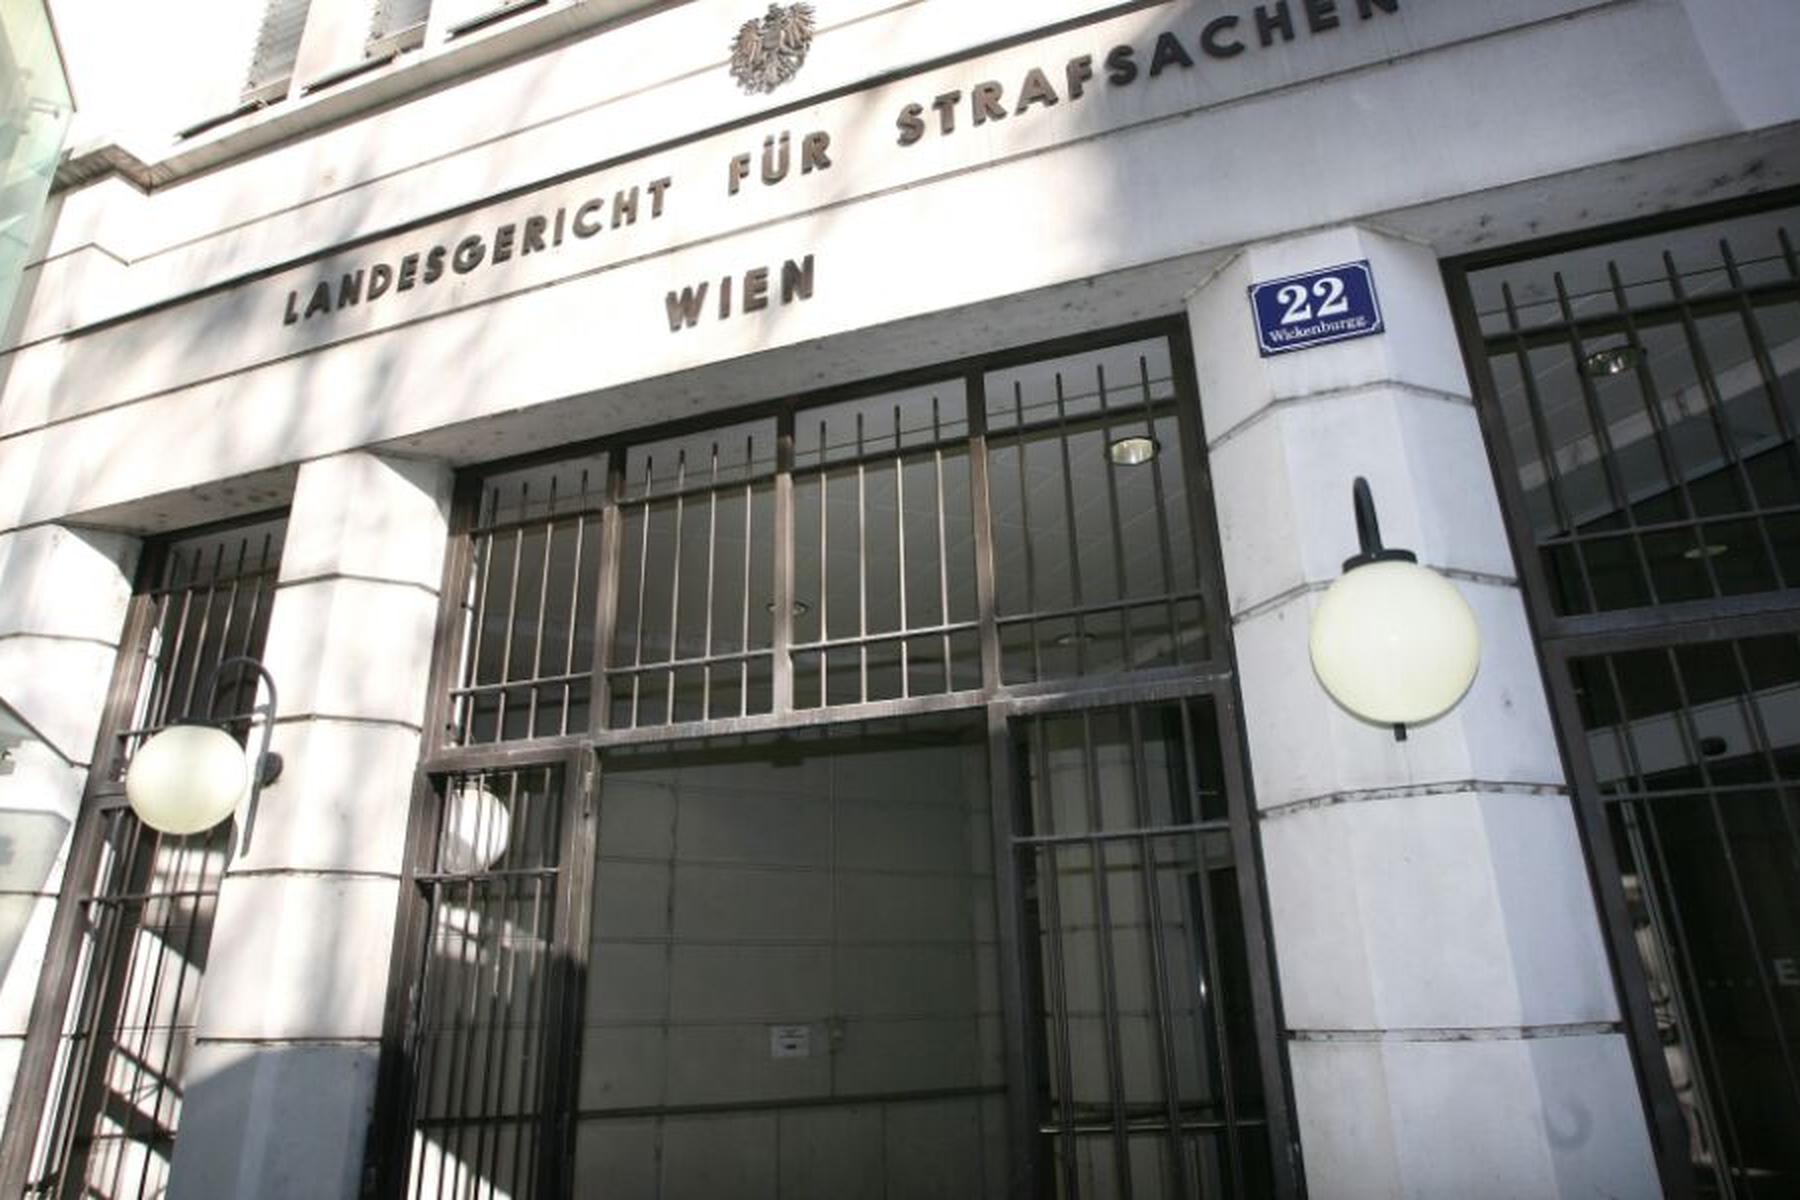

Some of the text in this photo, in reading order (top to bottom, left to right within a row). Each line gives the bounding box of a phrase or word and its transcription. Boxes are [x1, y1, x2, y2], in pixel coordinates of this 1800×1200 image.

[284, 177, 671, 325] LANDESGERICHT
[729, 131, 831, 195] FÜR
[665, 255, 815, 332] WIEN
[1277, 277, 1348, 324] 22
